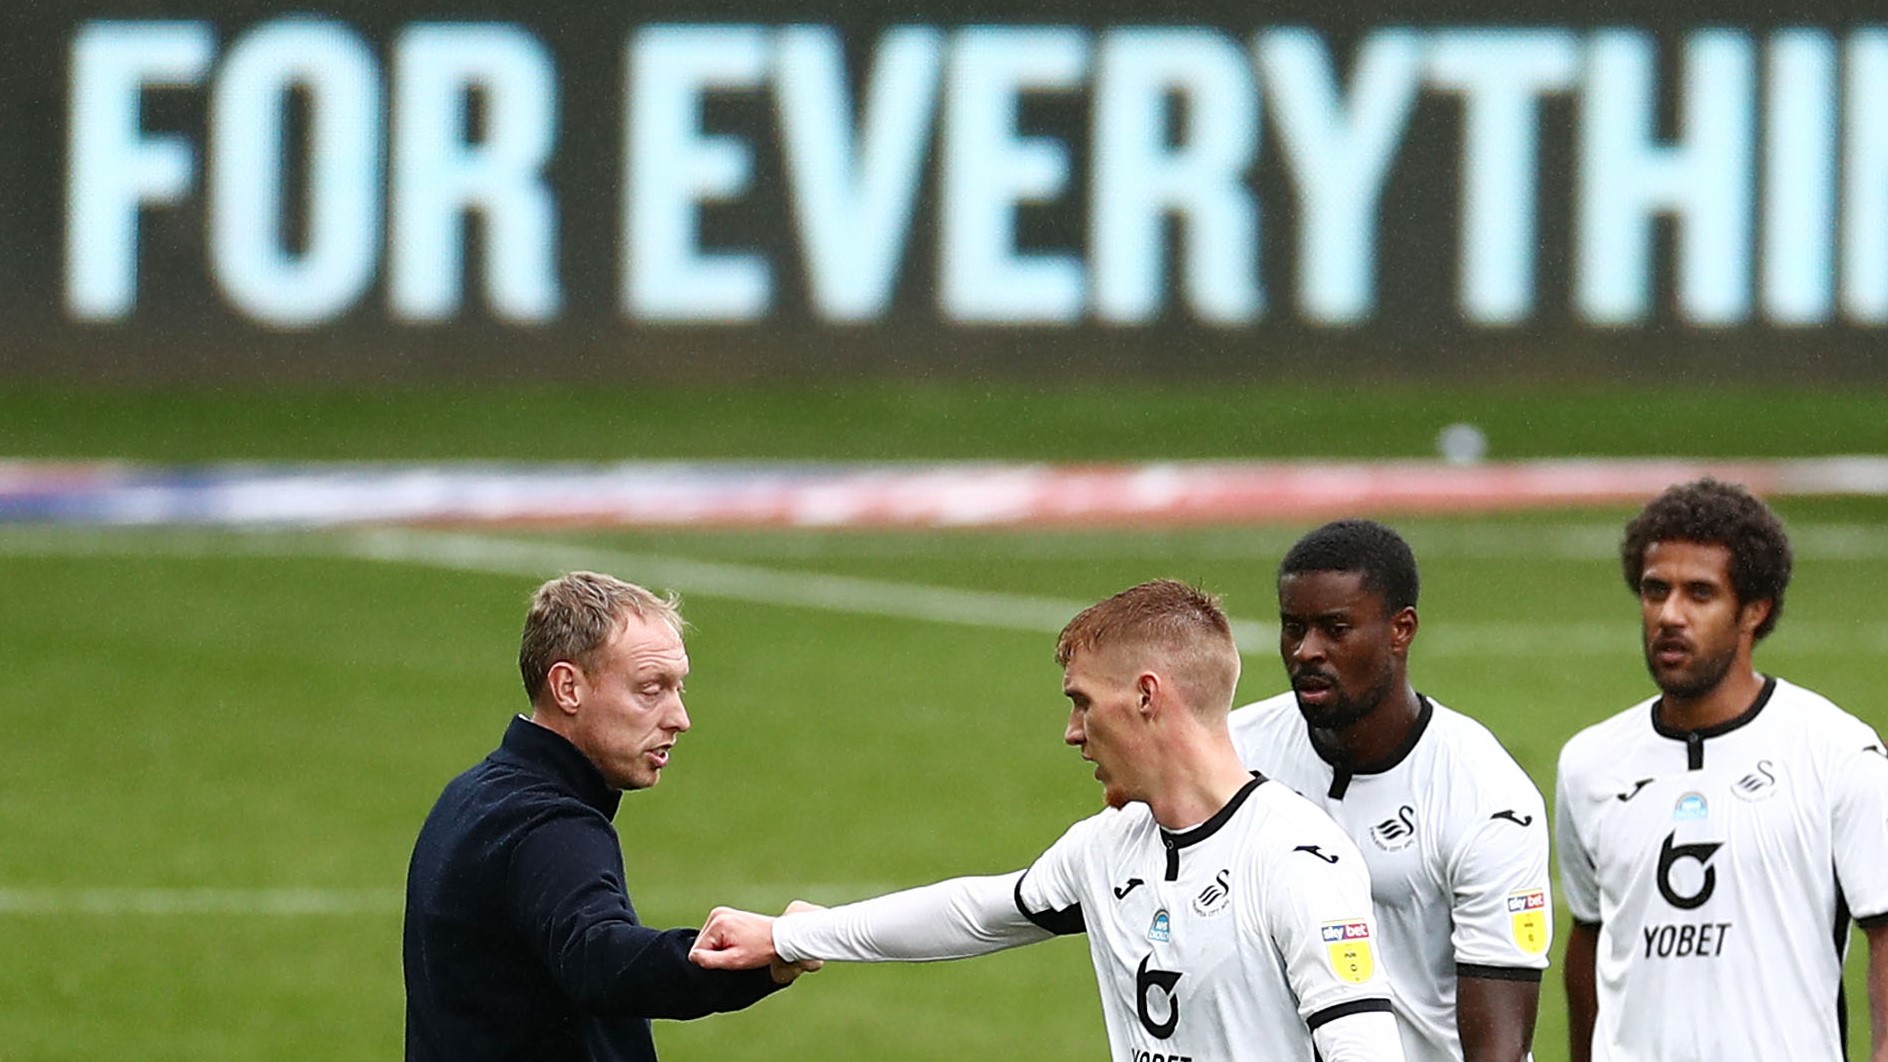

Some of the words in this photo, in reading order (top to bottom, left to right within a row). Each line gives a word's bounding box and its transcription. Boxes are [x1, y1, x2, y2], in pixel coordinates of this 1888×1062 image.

[66, 16, 562, 328] FOR
[1323, 926, 1344, 941] sky
[1345, 924, 1369, 938] bet
[1643, 922, 1733, 959] YOBET
